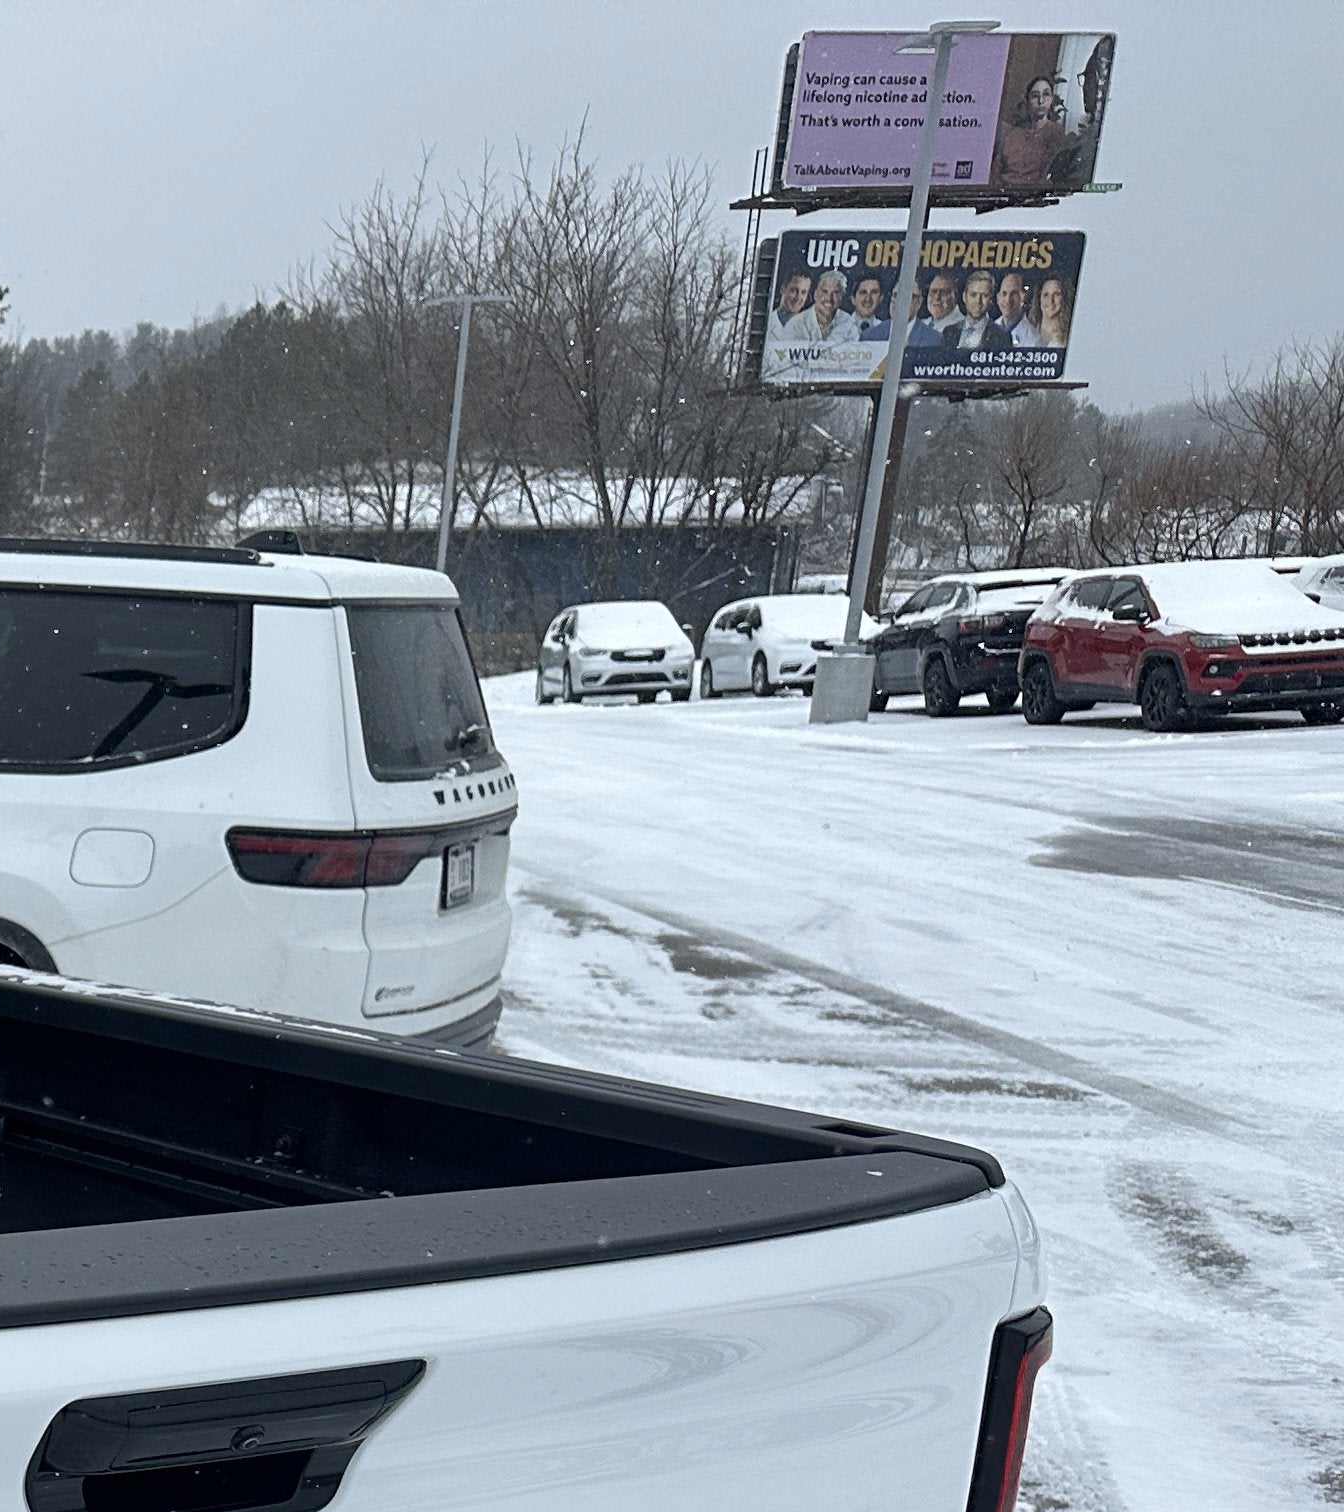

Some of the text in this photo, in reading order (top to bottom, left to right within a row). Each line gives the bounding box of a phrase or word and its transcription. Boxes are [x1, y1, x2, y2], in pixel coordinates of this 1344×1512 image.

[806, 72, 928, 88] Vaping can cause a
[802, 90, 976, 106] lifelong nicotine adtion.
[800, 114, 982, 128] That's worth a convsation.
[794, 164, 911, 177] TalkAboutVaping.org
[806, 239, 1054, 269] UHC ORHOPAEDICS
[970, 351, 1058, 363] 681-342-3500
[914, 363, 1056, 377] wvorthocenter.com
